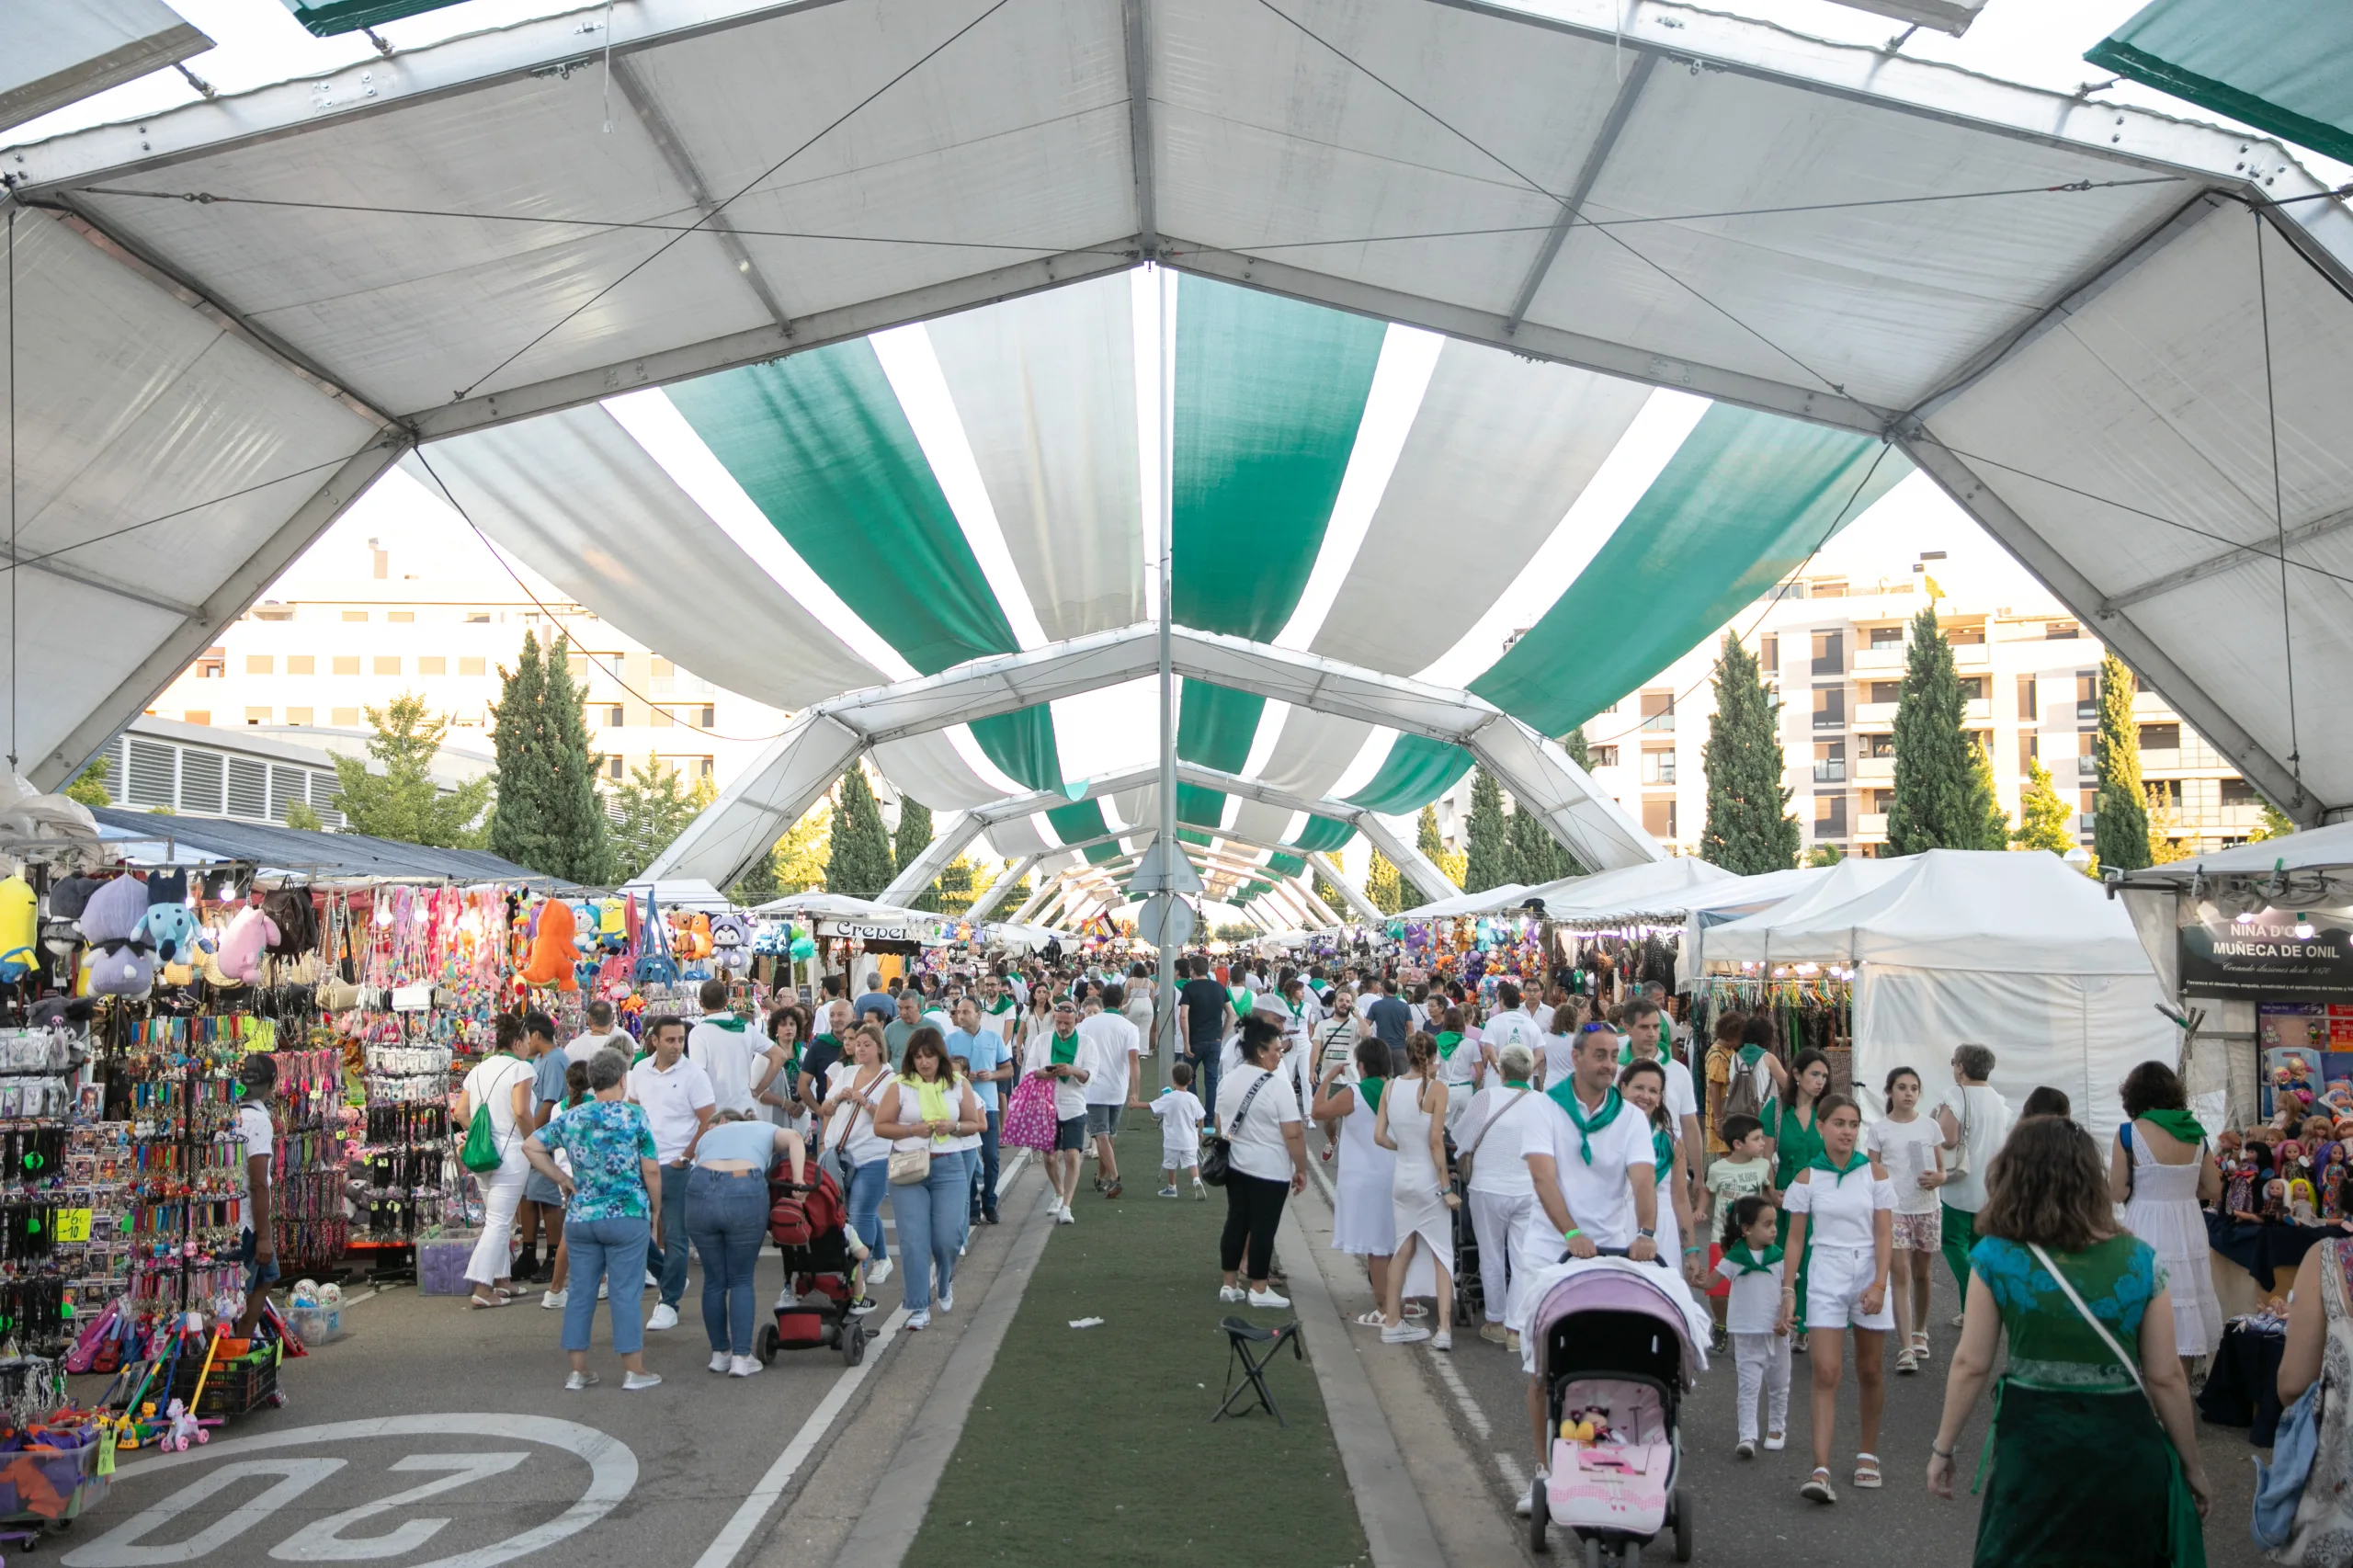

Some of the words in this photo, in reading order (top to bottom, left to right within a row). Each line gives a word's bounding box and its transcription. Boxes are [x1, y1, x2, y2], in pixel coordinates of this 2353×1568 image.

[2231, 924, 2267, 937] NINA
[2213, 941, 2278, 957] MUÑECA
[2281, 945, 2302, 957] DE
[2306, 946, 2340, 959] ONIL
[2222, 961, 2255, 972] Creando
[2256, 962, 2289, 973] ilusiones
[2290, 965, 2309, 974] desde
[60, 1451, 531, 1568] 20
